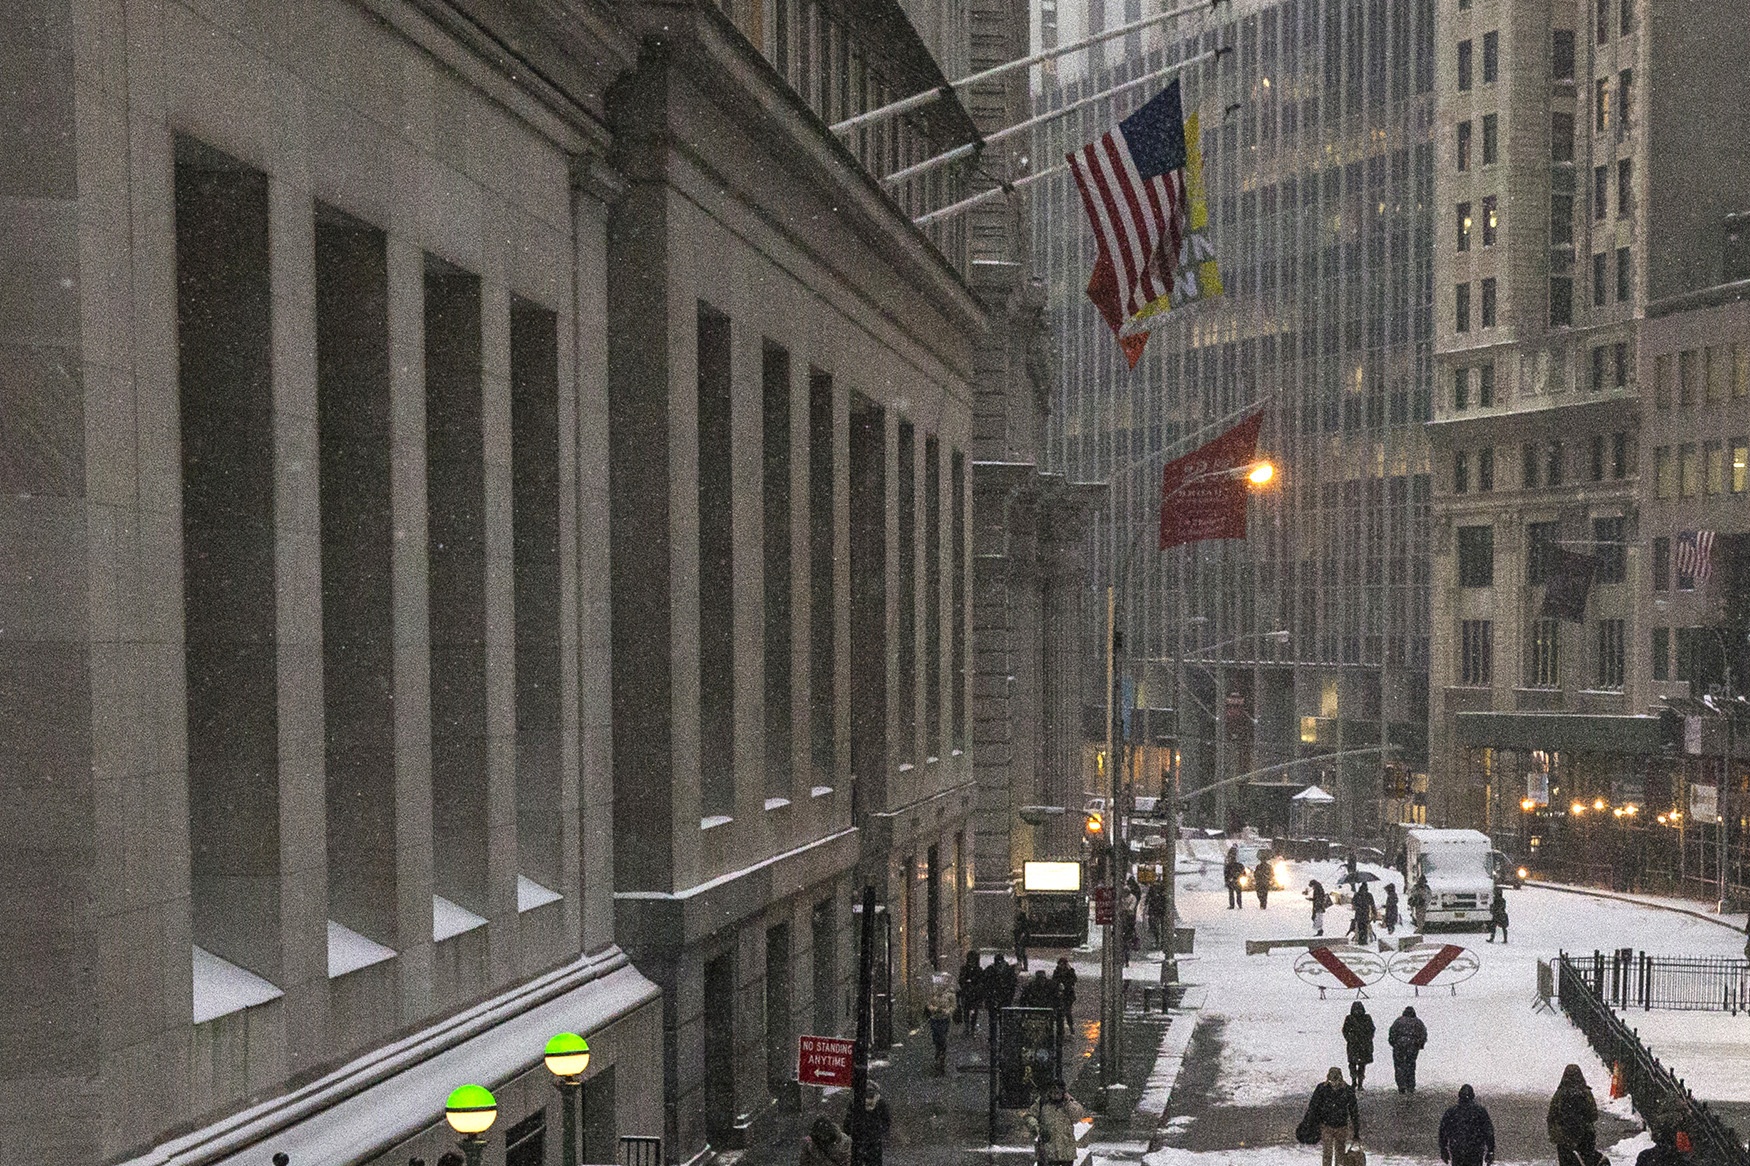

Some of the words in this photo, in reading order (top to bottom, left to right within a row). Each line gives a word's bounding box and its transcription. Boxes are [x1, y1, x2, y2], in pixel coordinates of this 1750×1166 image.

[802, 1041, 814, 1051] NO
[816, 1041, 853, 1055] STANDING
[808, 1055, 846, 1068] ANYTIME
